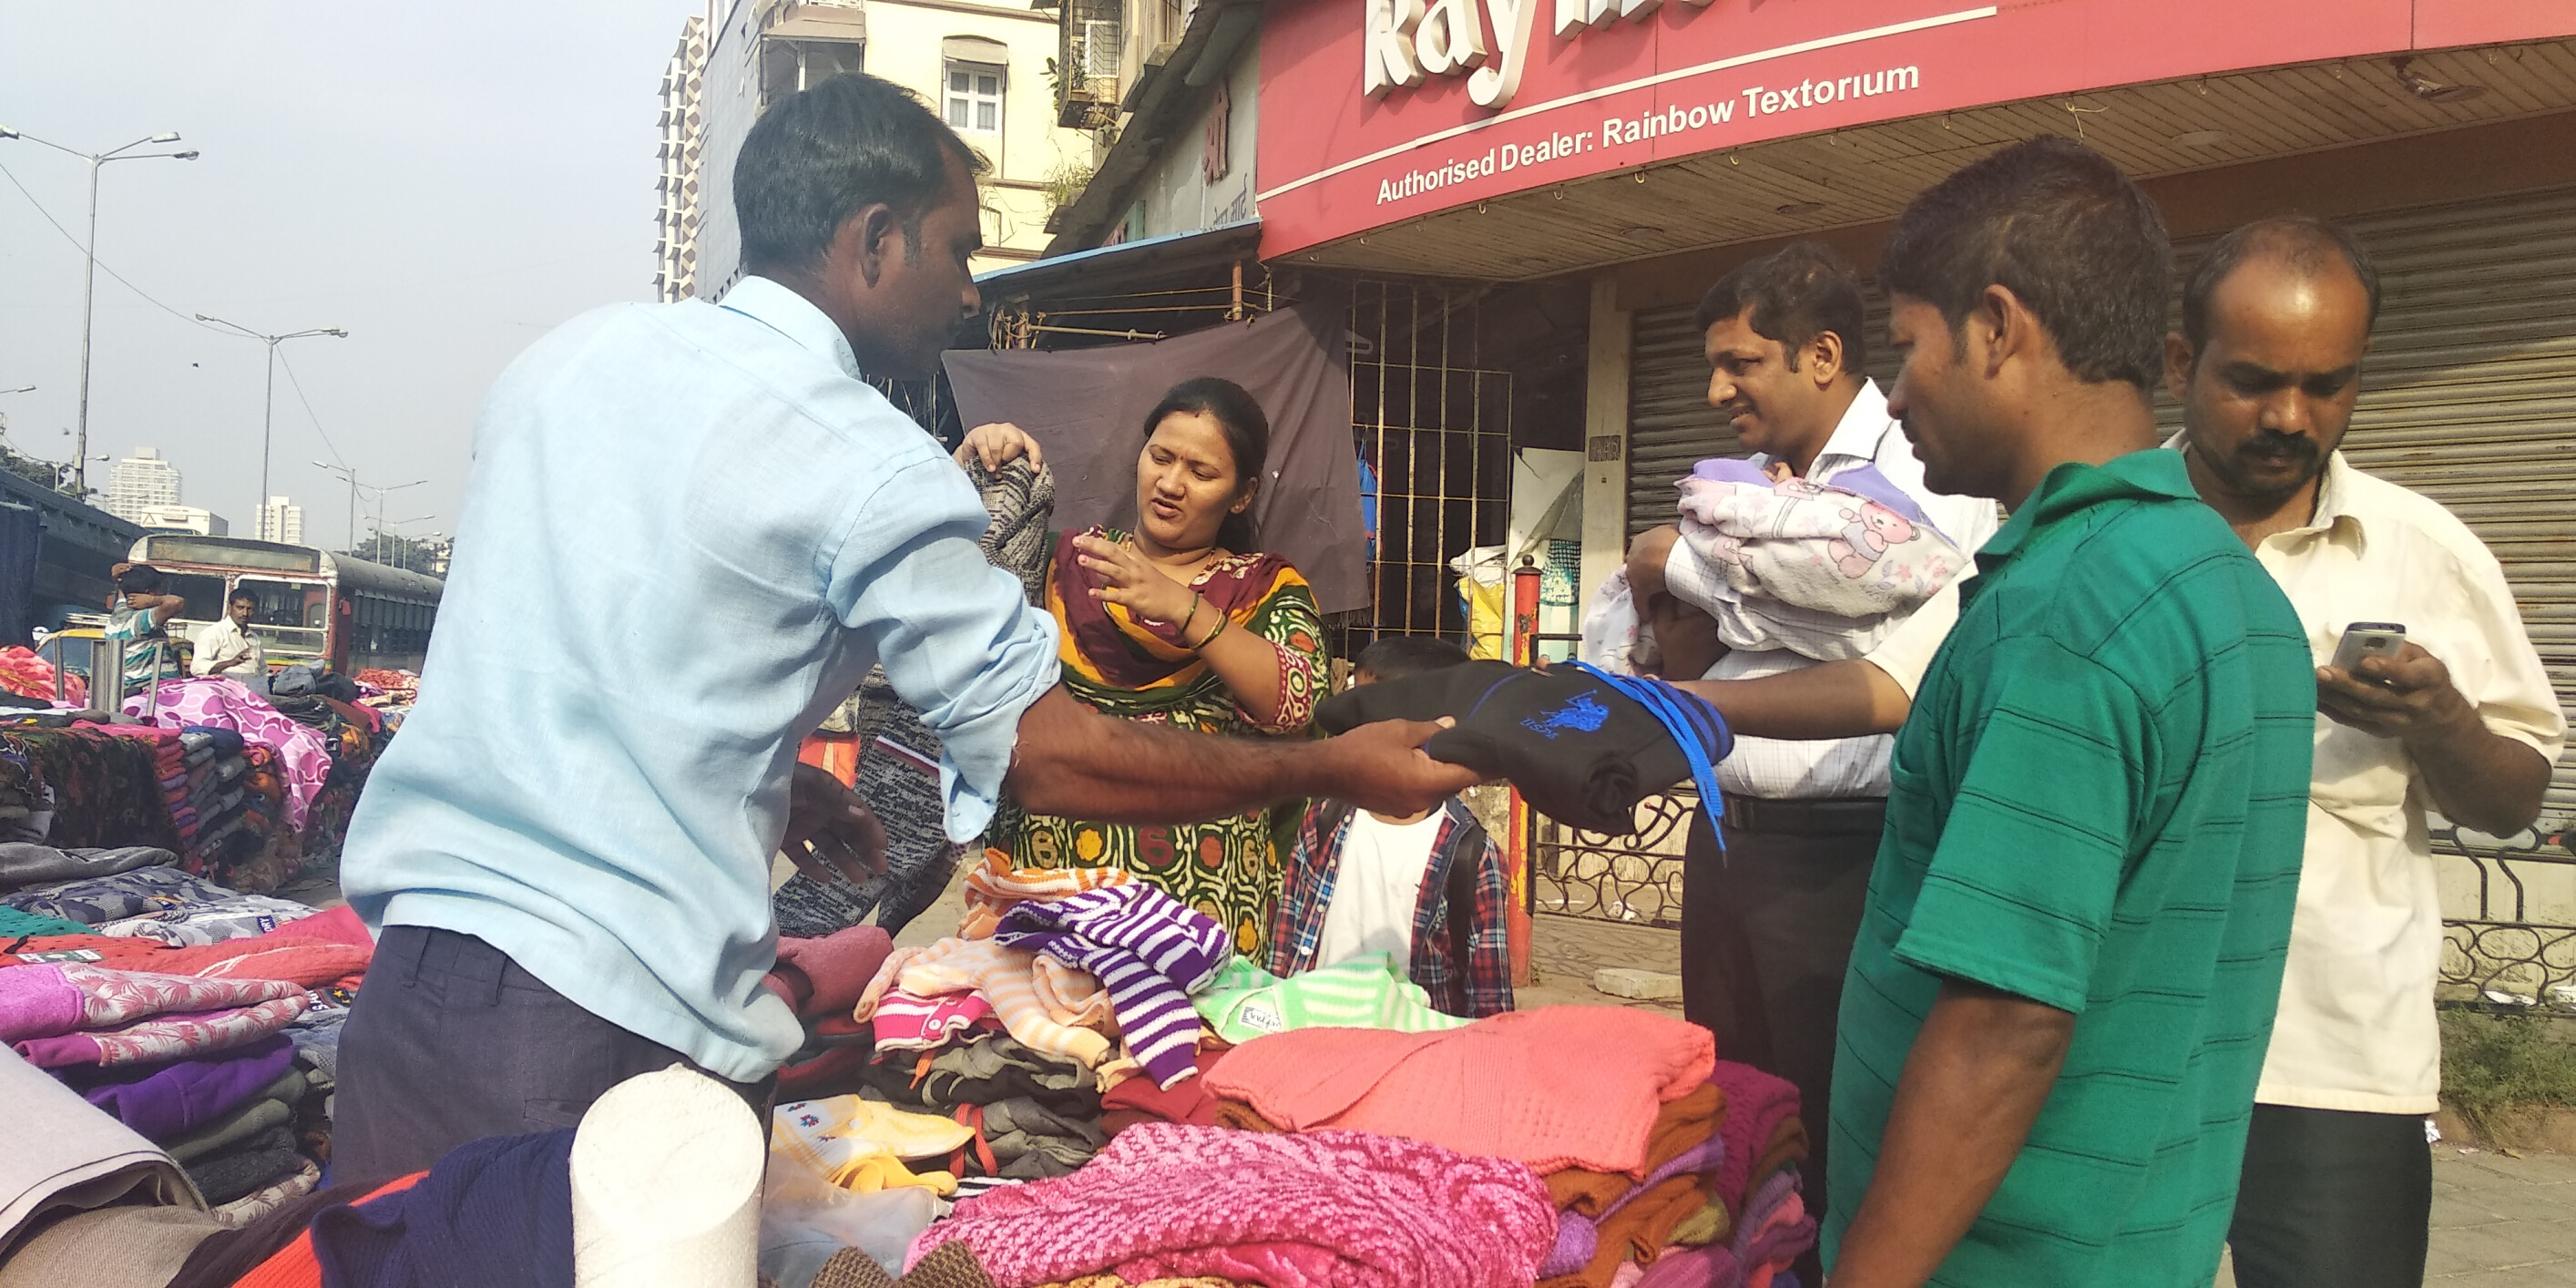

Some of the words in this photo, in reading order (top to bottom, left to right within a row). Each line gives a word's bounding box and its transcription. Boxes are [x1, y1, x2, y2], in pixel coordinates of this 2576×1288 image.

[1376, 148, 1495, 205] Authorised
[1500, 130, 1593, 172] Dealer:
[1602, 99, 1735, 148] Rainbow
